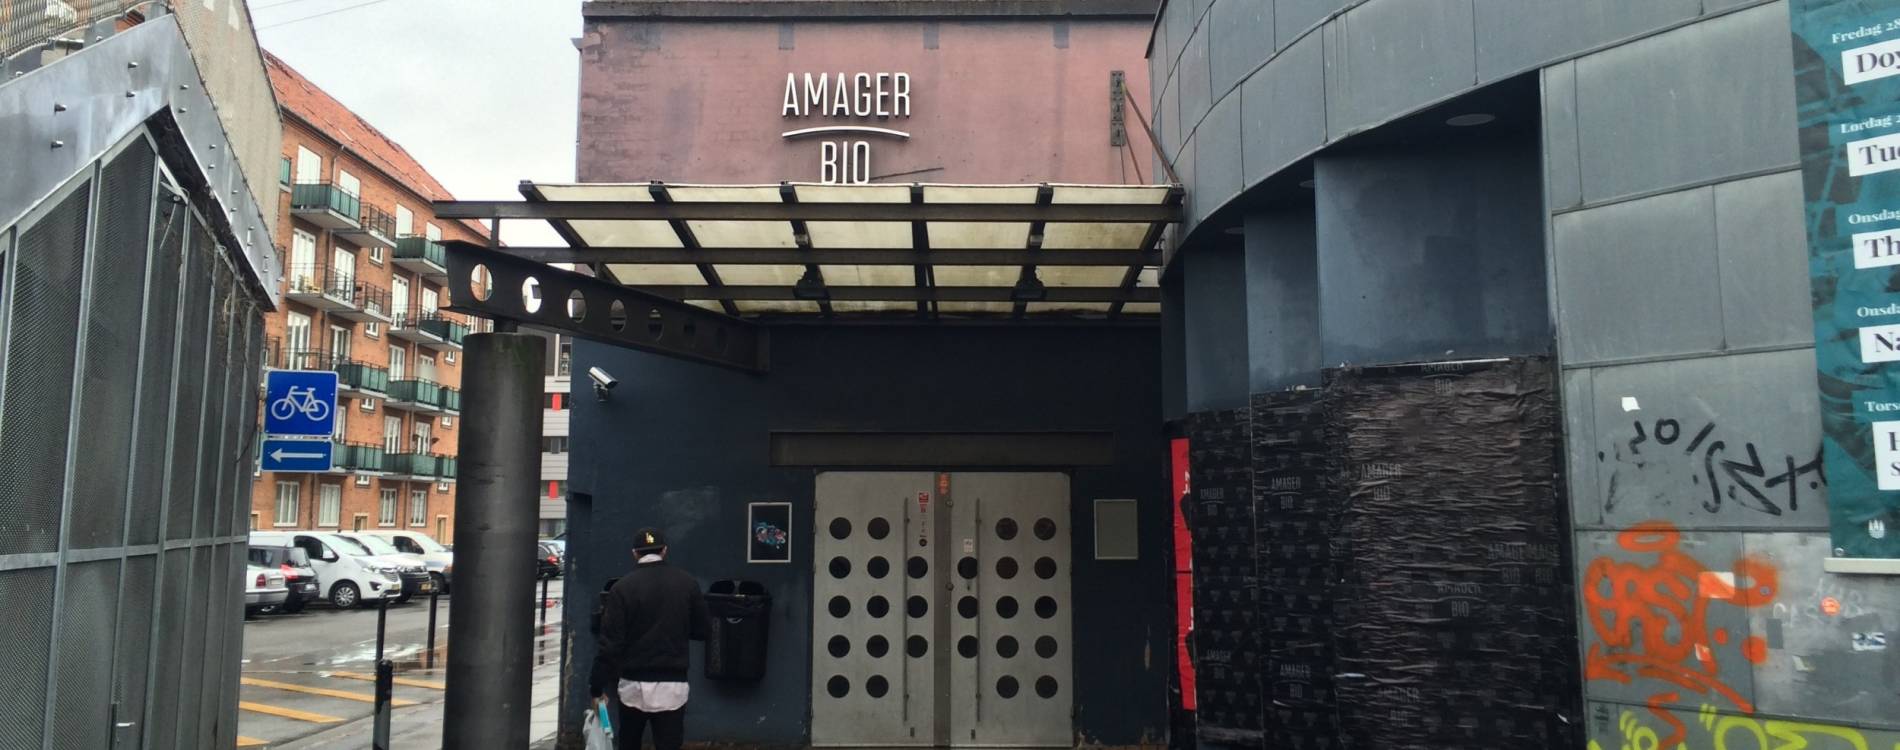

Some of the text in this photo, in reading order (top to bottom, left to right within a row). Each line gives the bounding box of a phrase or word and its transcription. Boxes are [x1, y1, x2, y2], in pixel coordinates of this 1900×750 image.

[1832, 23, 1882, 44] Fredag
[782, 72, 910, 117] AMAGER
[821, 141, 870, 184] BIO
[1859, 144, 1900, 165] Tu
[1271, 476, 1301, 490] AMAGER
[1451, 600, 1469, 617] BIO
